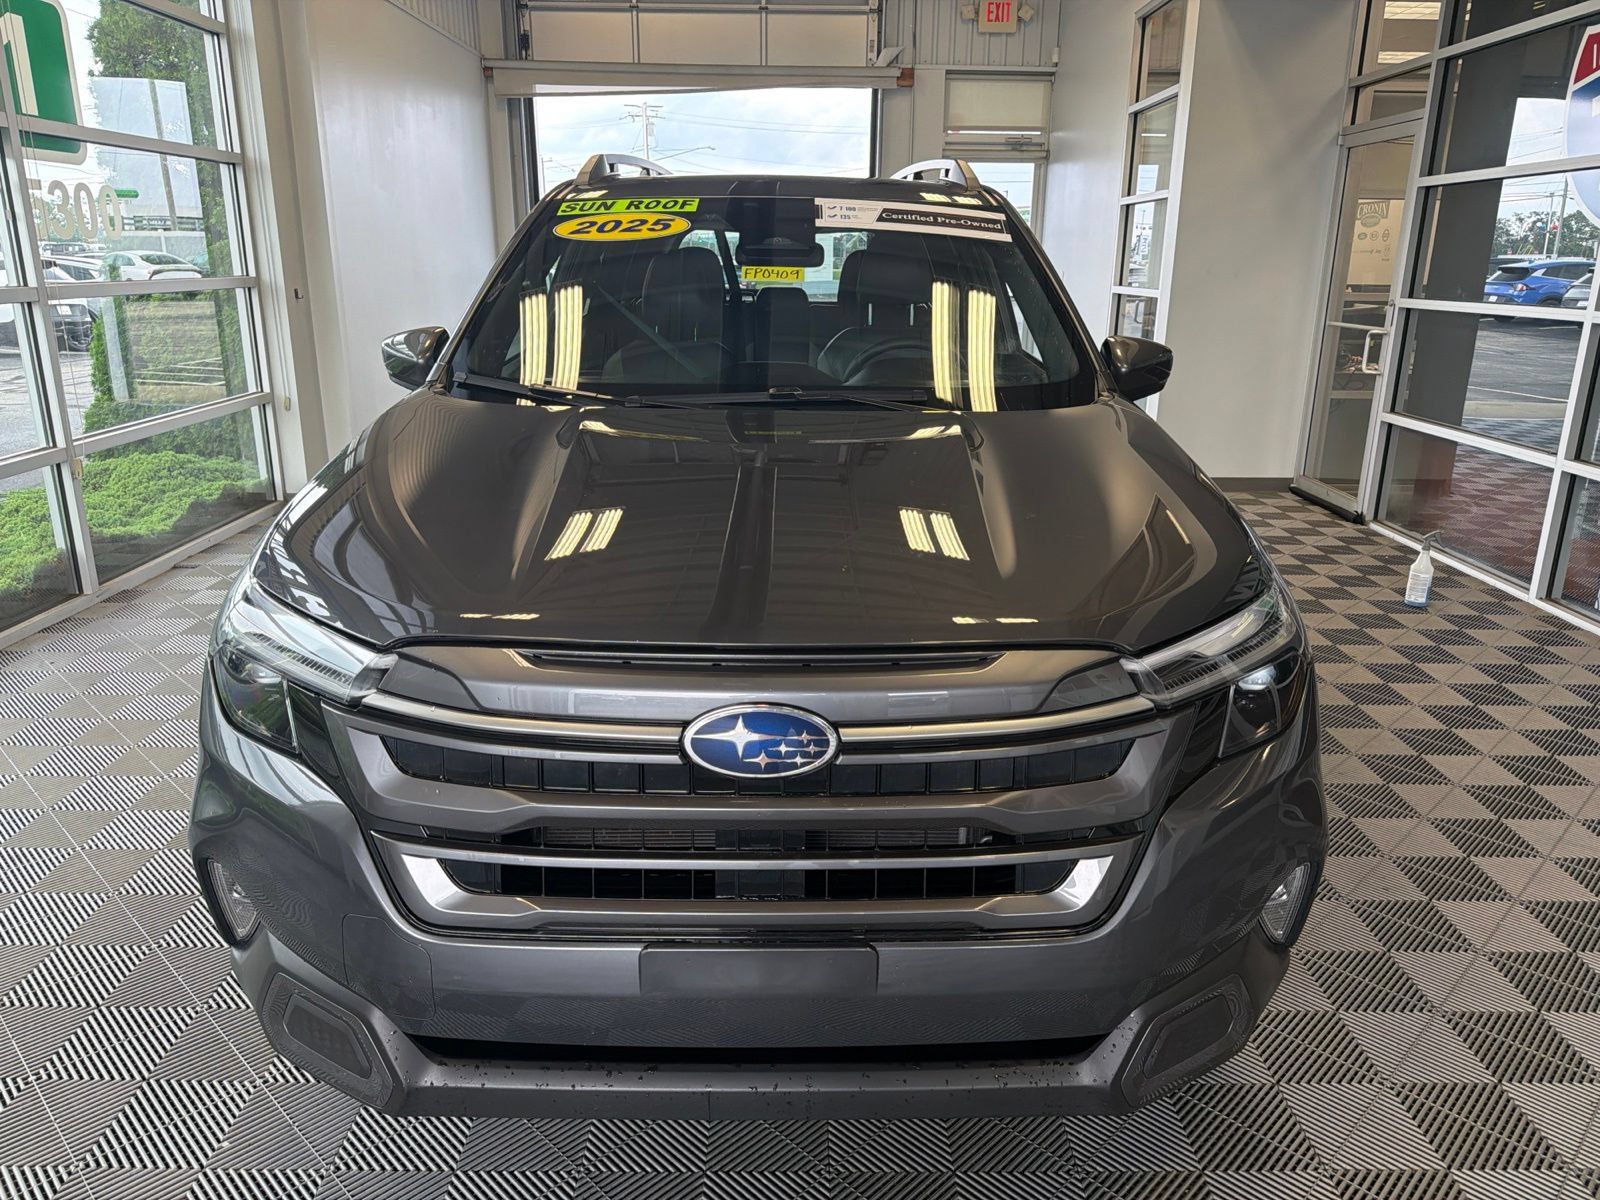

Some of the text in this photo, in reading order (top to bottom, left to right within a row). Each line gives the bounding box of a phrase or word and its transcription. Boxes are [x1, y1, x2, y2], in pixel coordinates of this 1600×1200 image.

[986, 2, 1012, 22] EXIT
[560, 199, 696, 213] SUN ROOF
[567, 218, 676, 235] 2025
[881, 212, 1002, 229] Certified Pre-Owned
